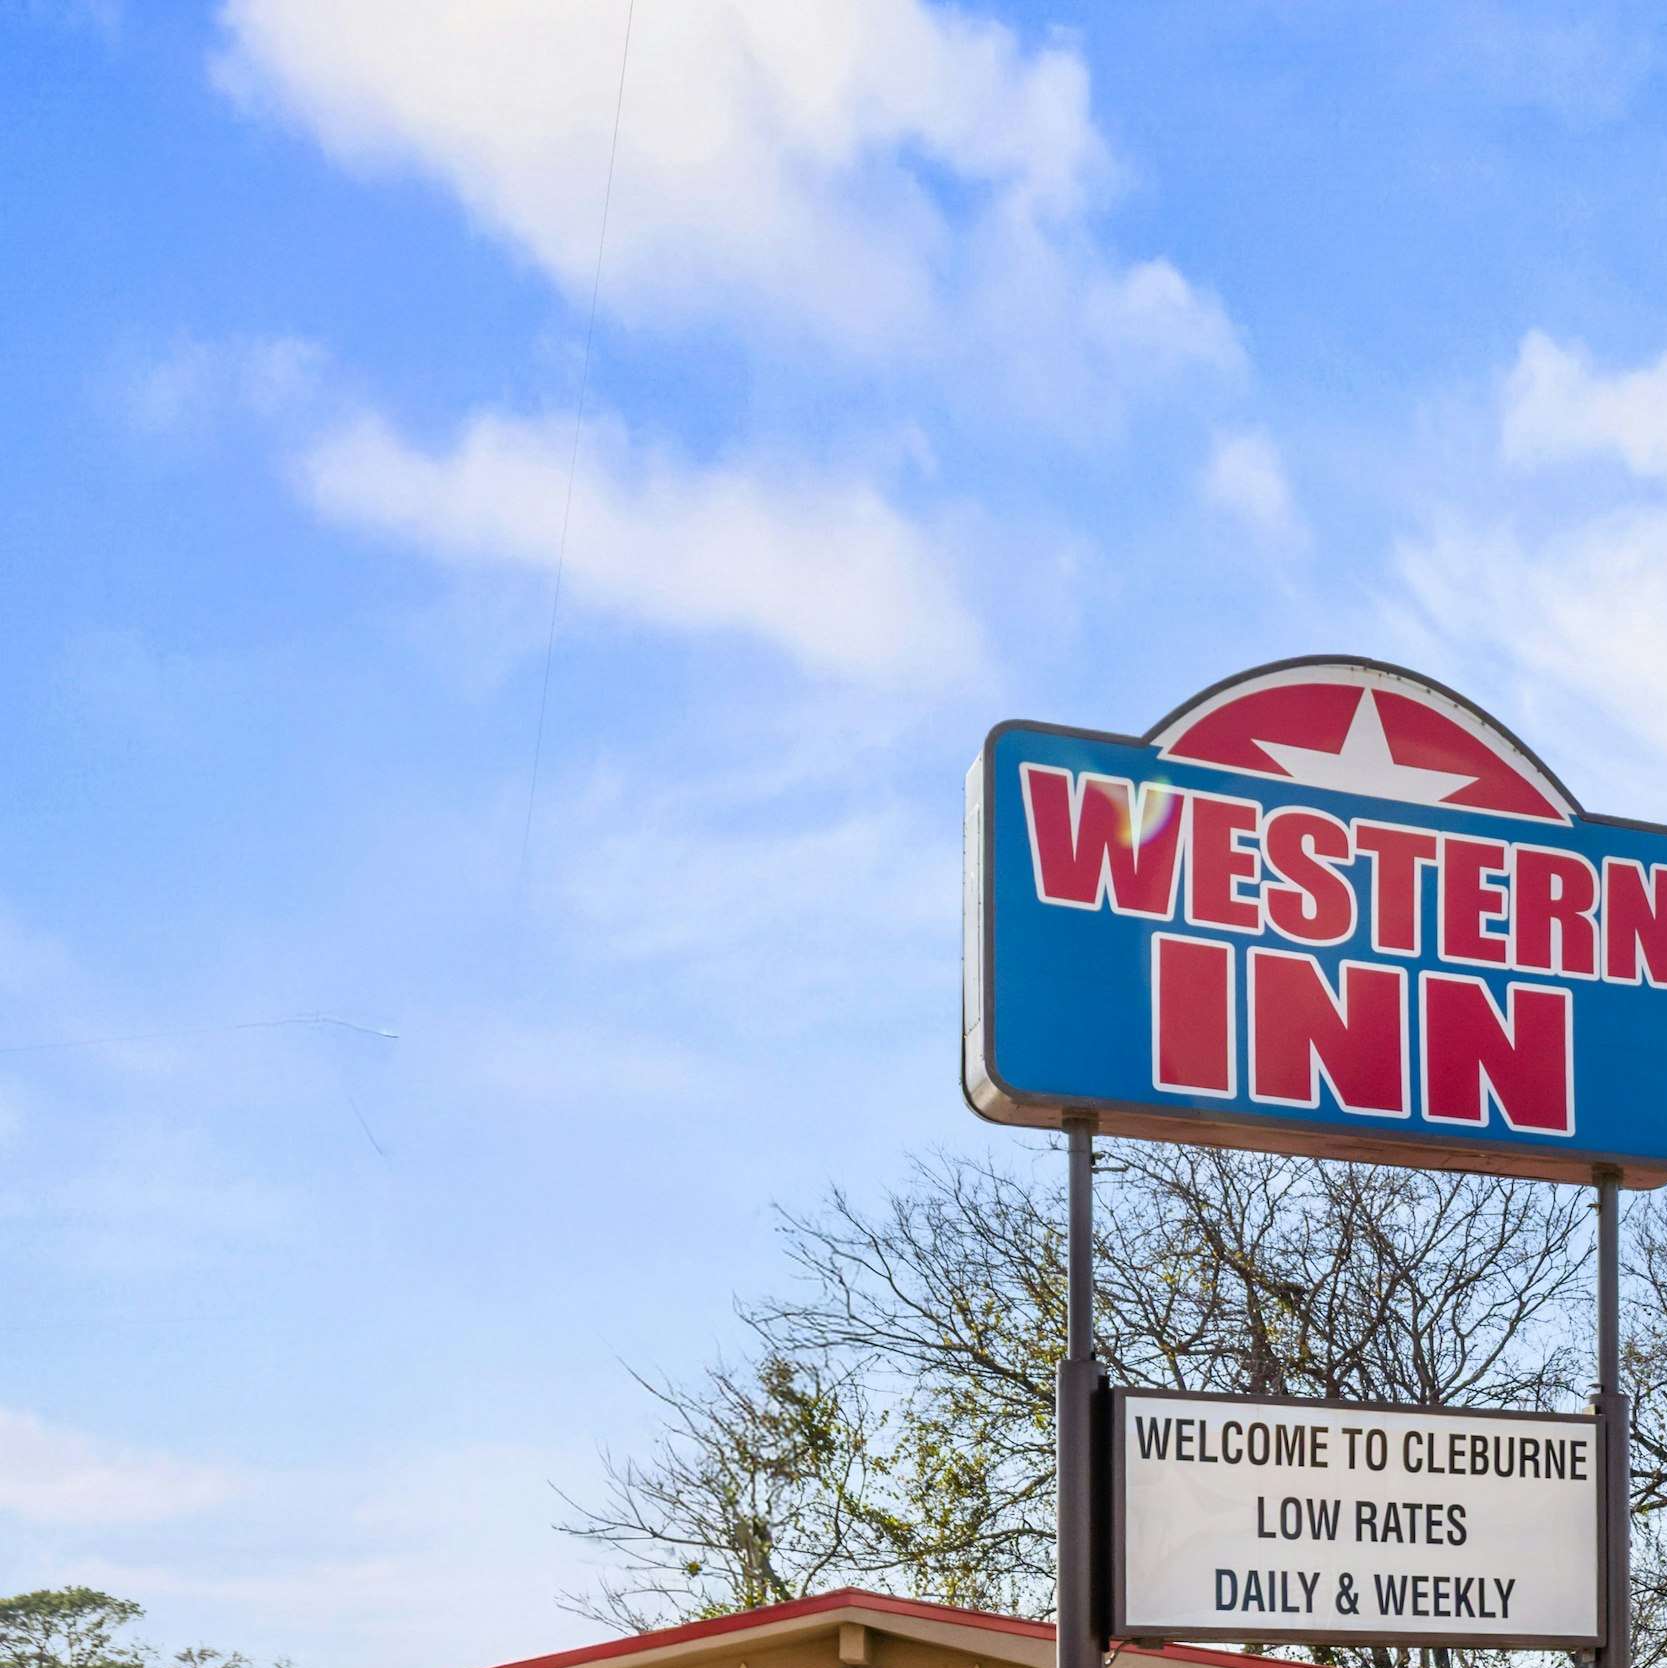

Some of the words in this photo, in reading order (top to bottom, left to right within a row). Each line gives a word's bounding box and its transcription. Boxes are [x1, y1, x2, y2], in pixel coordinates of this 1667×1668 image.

[1150, 931, 1576, 1138] INN
[1135, 1415, 1329, 1468] WELCOME
[1341, 1428, 1388, 1472] TO
[1403, 1430, 1589, 1481] CLEBURNE
[1257, 1496, 1342, 1541] LOW
[1354, 1500, 1468, 1547] RATES
[1214, 1568, 1322, 1614] DAILY
[1335, 1571, 1360, 1615] &
[1373, 1573, 1517, 1619] WEEKLY
